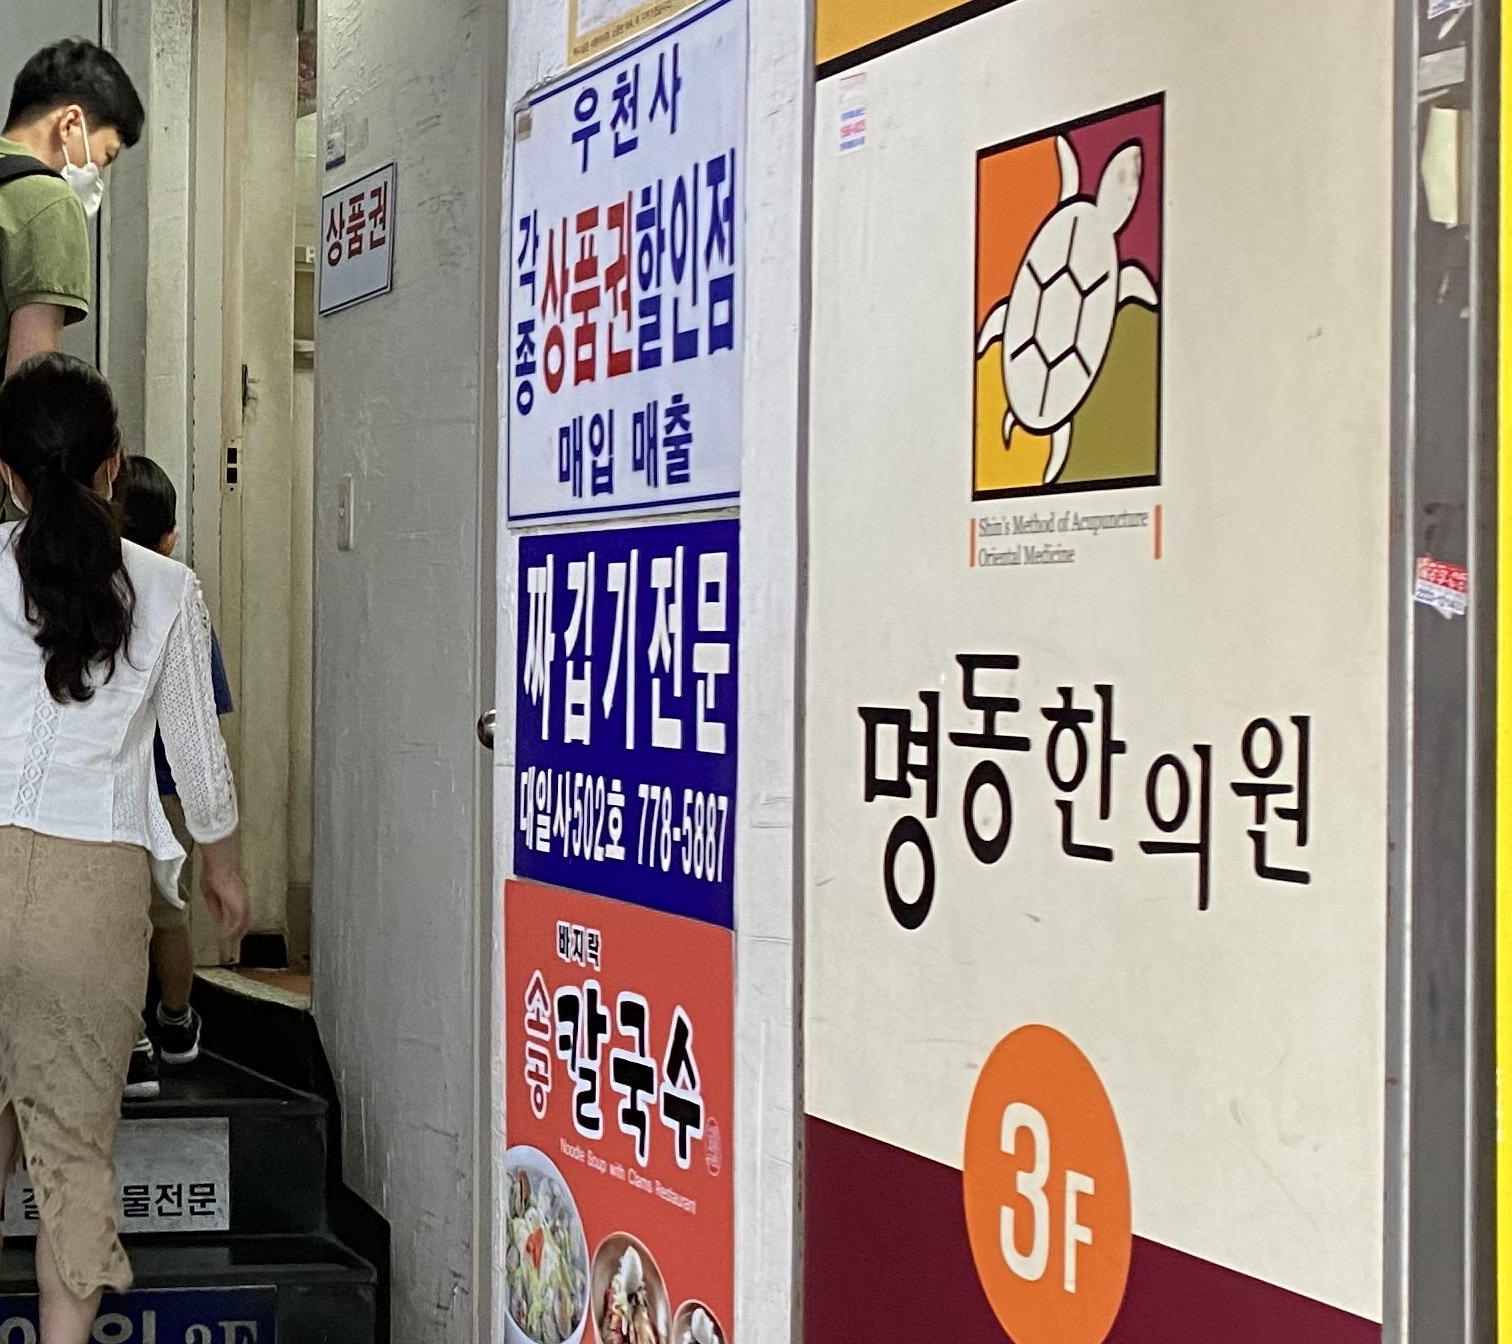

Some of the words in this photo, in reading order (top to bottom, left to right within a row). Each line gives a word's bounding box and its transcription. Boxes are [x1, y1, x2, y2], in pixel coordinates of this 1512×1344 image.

[571, 42, 683, 174] 우천사
[326, 180, 389, 268] 상품권
[541, 146, 737, 396] 상품권할인점
[515, 208, 539, 416] 각종
[558, 408, 616, 500] 매입
[631, 392, 694, 490] 매출
[1011, 512, 1056, 535] Method
[1056, 510, 1071, 532] of
[522, 544, 731, 756] 짜깁기전문
[637, 782, 728, 883] 778-5887
[857, 652, 1312, 931] 명동한의원
[556, 920, 602, 972] 바지락
[554, 980, 704, 1170] 칼국수
[998, 1101, 1096, 1295] 3F
